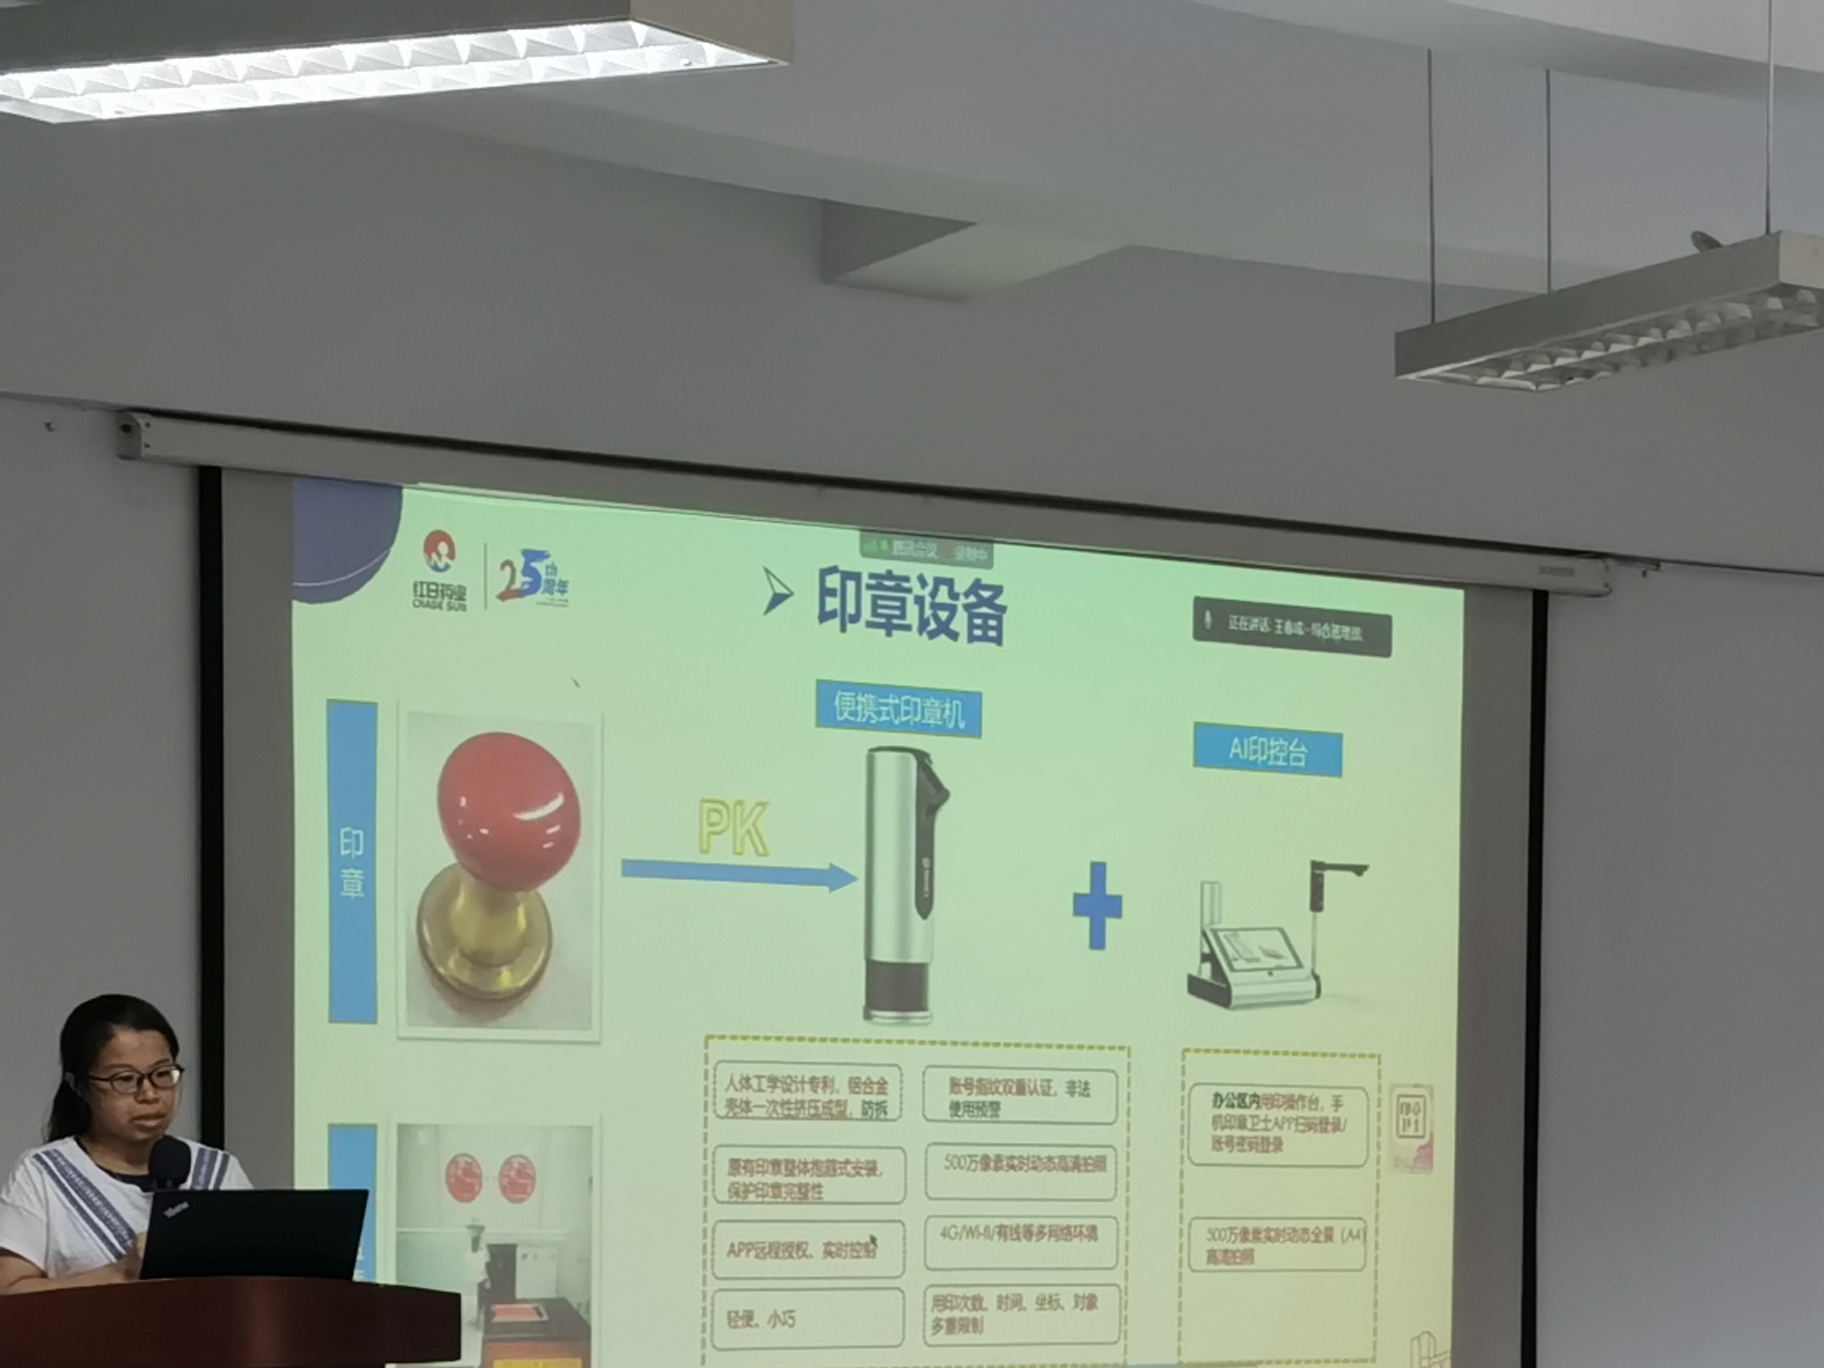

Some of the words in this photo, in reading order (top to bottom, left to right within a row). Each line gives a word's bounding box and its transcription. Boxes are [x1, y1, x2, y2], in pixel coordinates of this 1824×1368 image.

[446, 600, 468, 613] SUN
[817, 564, 1008, 648] 印章设备
[833, 689, 966, 730] 便携式印章机
[1228, 735, 1309, 769] AI印控台
[698, 797, 770, 858] PK
[340, 826, 366, 899] 印章
